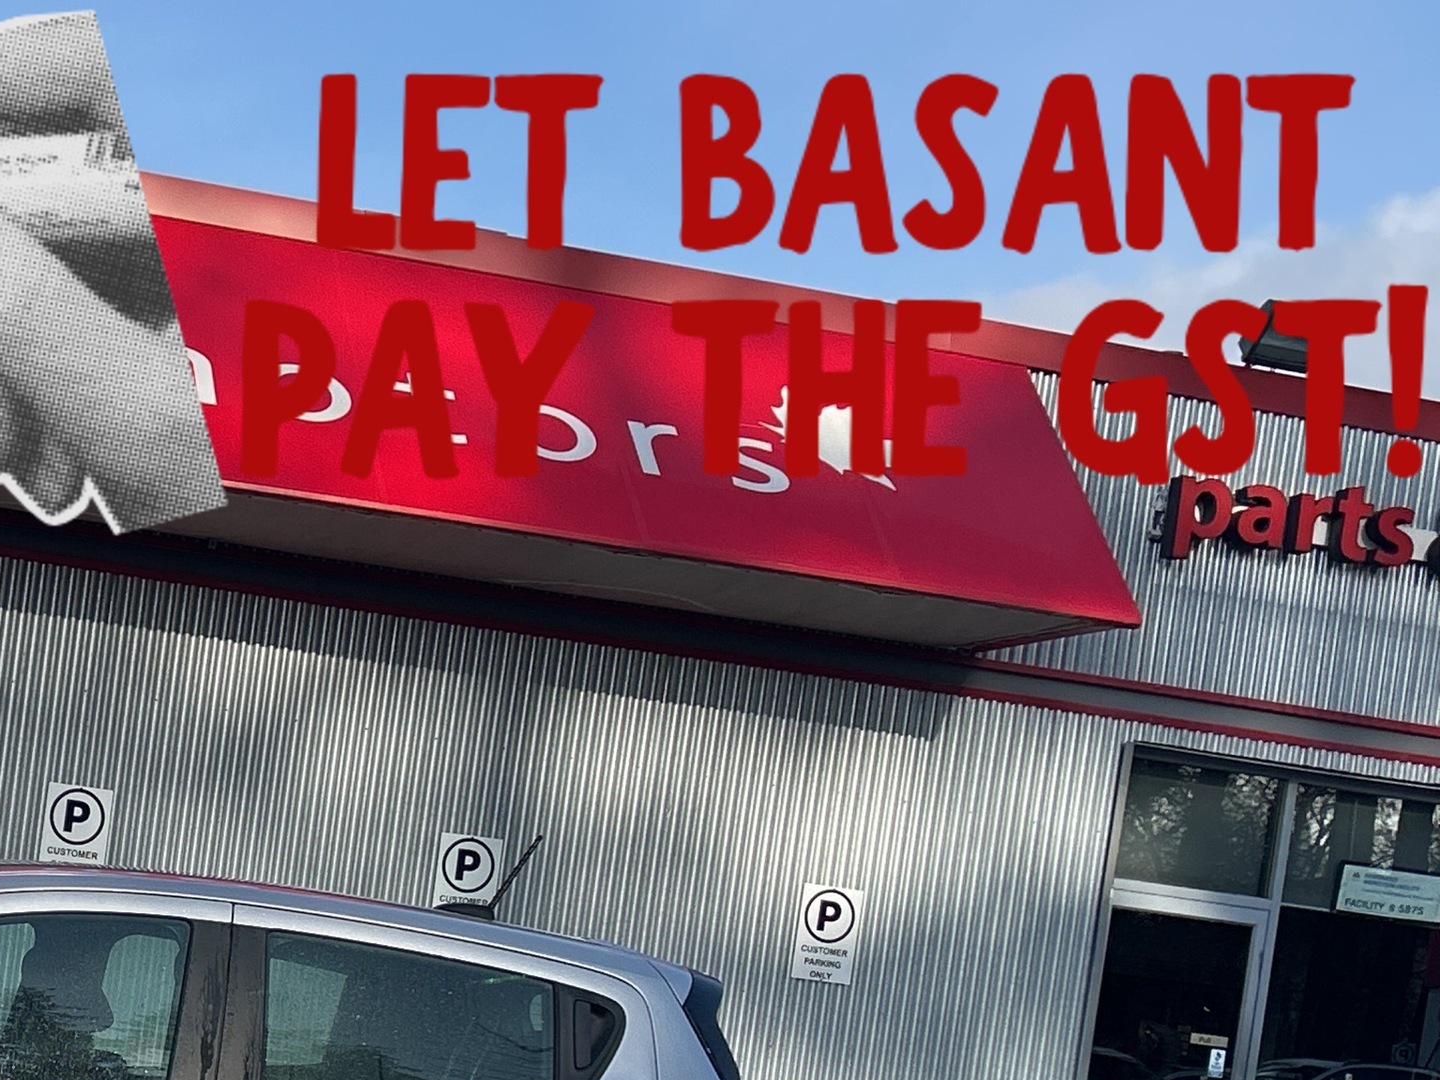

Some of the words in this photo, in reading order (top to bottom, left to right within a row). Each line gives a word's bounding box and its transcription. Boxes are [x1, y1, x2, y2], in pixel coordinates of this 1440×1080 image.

[1161, 475, 1414, 566] parts
[63, 799, 90, 832] P
[46, 846, 98, 860] CUSTOMER
[454, 848, 481, 881] P
[1344, 897, 1385, 911] FACILITY
[816, 899, 842, 931] P
[800, 944, 848, 957] CUSTOMER
[804, 957, 841, 969] PARKING
[809, 970, 832, 980] ONLY
